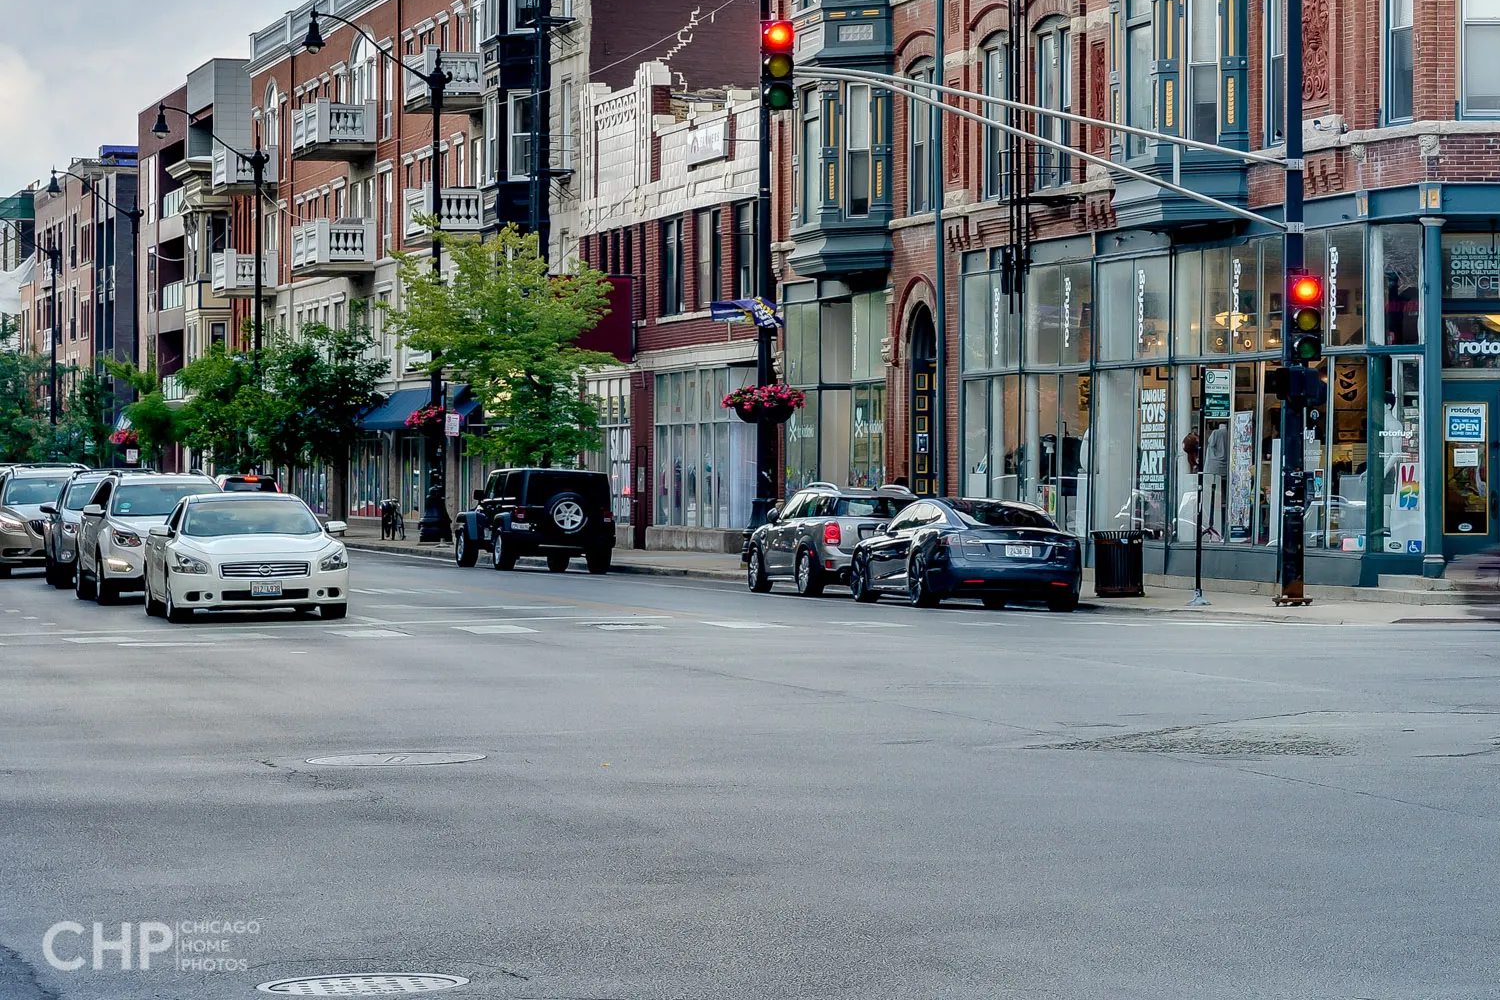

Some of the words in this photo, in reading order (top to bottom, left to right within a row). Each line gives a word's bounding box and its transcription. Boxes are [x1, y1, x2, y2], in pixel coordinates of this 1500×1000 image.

[1327, 247, 1338, 330] rotofugi
[1451, 276, 1499, 290] SINCE
[1141, 389, 1166, 402] UNIQUE
[1141, 403, 1166, 422] TOYS
[1450, 407, 1481, 415] rotofugi
[1451, 423, 1480, 431] OPEN
[1379, 430, 1413, 439] rotofugi
[1141, 439, 1165, 450] ORIGINAL
[1140, 451, 1165, 474] ART
